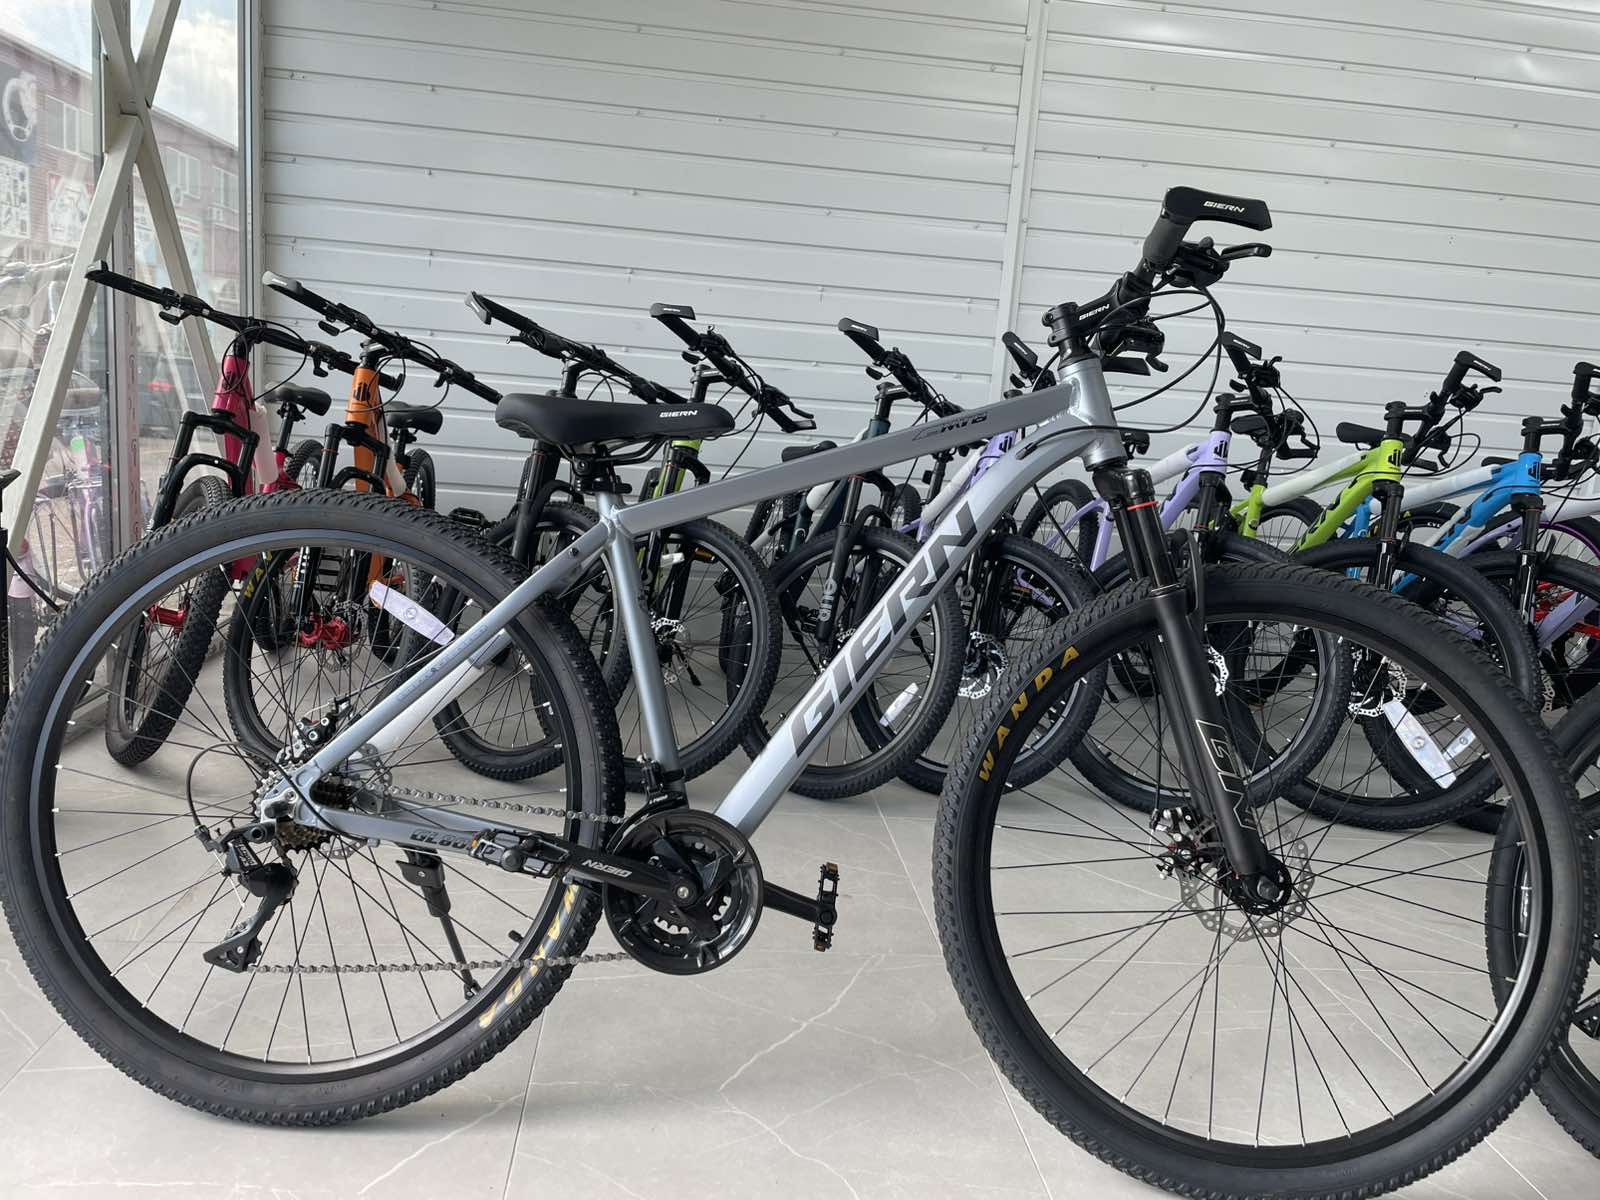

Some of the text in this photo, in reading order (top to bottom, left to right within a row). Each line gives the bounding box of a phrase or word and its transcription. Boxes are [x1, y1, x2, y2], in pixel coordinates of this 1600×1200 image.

[1203, 200, 1246, 213] GIERN
[1078, 303, 1110, 321] GIERN
[659, 409, 699, 418] GIERN
[790, 500, 978, 758] GIERN
[978, 645, 1081, 783] WANDA
[581, 859, 634, 879] GIERN
